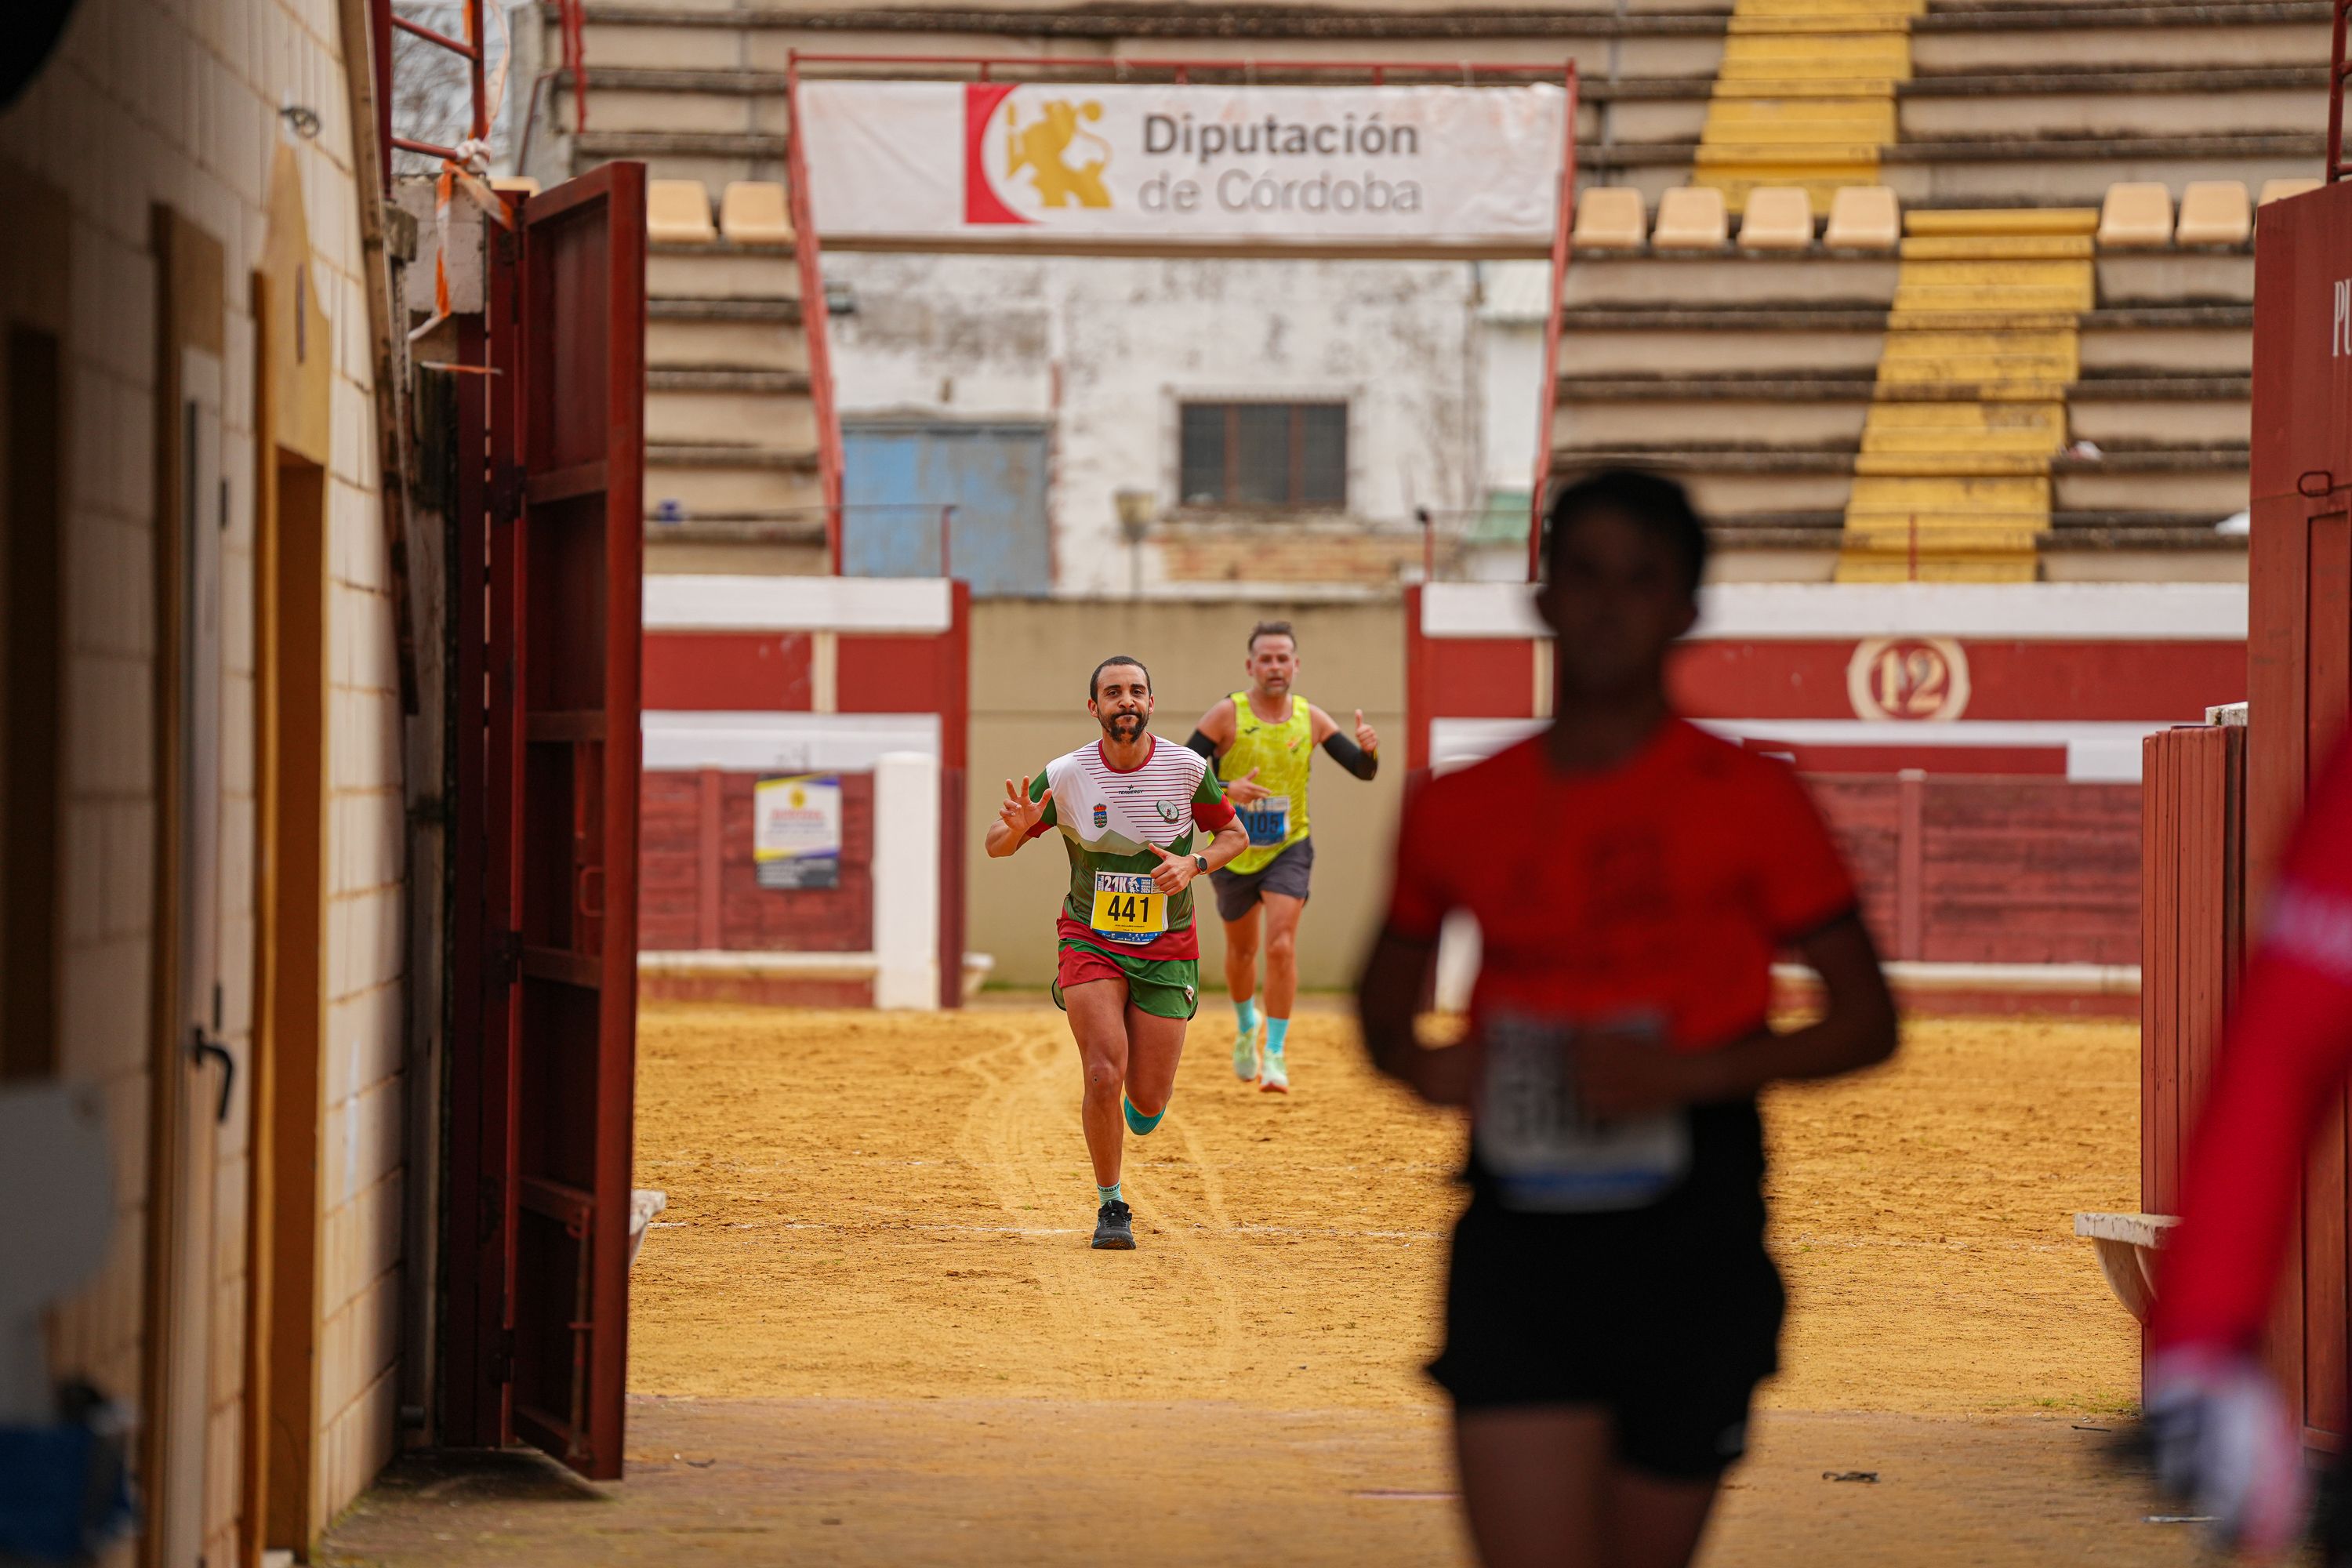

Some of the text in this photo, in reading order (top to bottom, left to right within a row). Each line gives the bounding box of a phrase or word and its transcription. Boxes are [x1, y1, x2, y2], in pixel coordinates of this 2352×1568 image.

[1142, 111, 1419, 165] Diputación
[1138, 168, 1423, 214] de Córdoba
[1882, 647, 1945, 713] 12
[1104, 875, 1127, 893] 21K
[1107, 895, 1149, 923] 441
